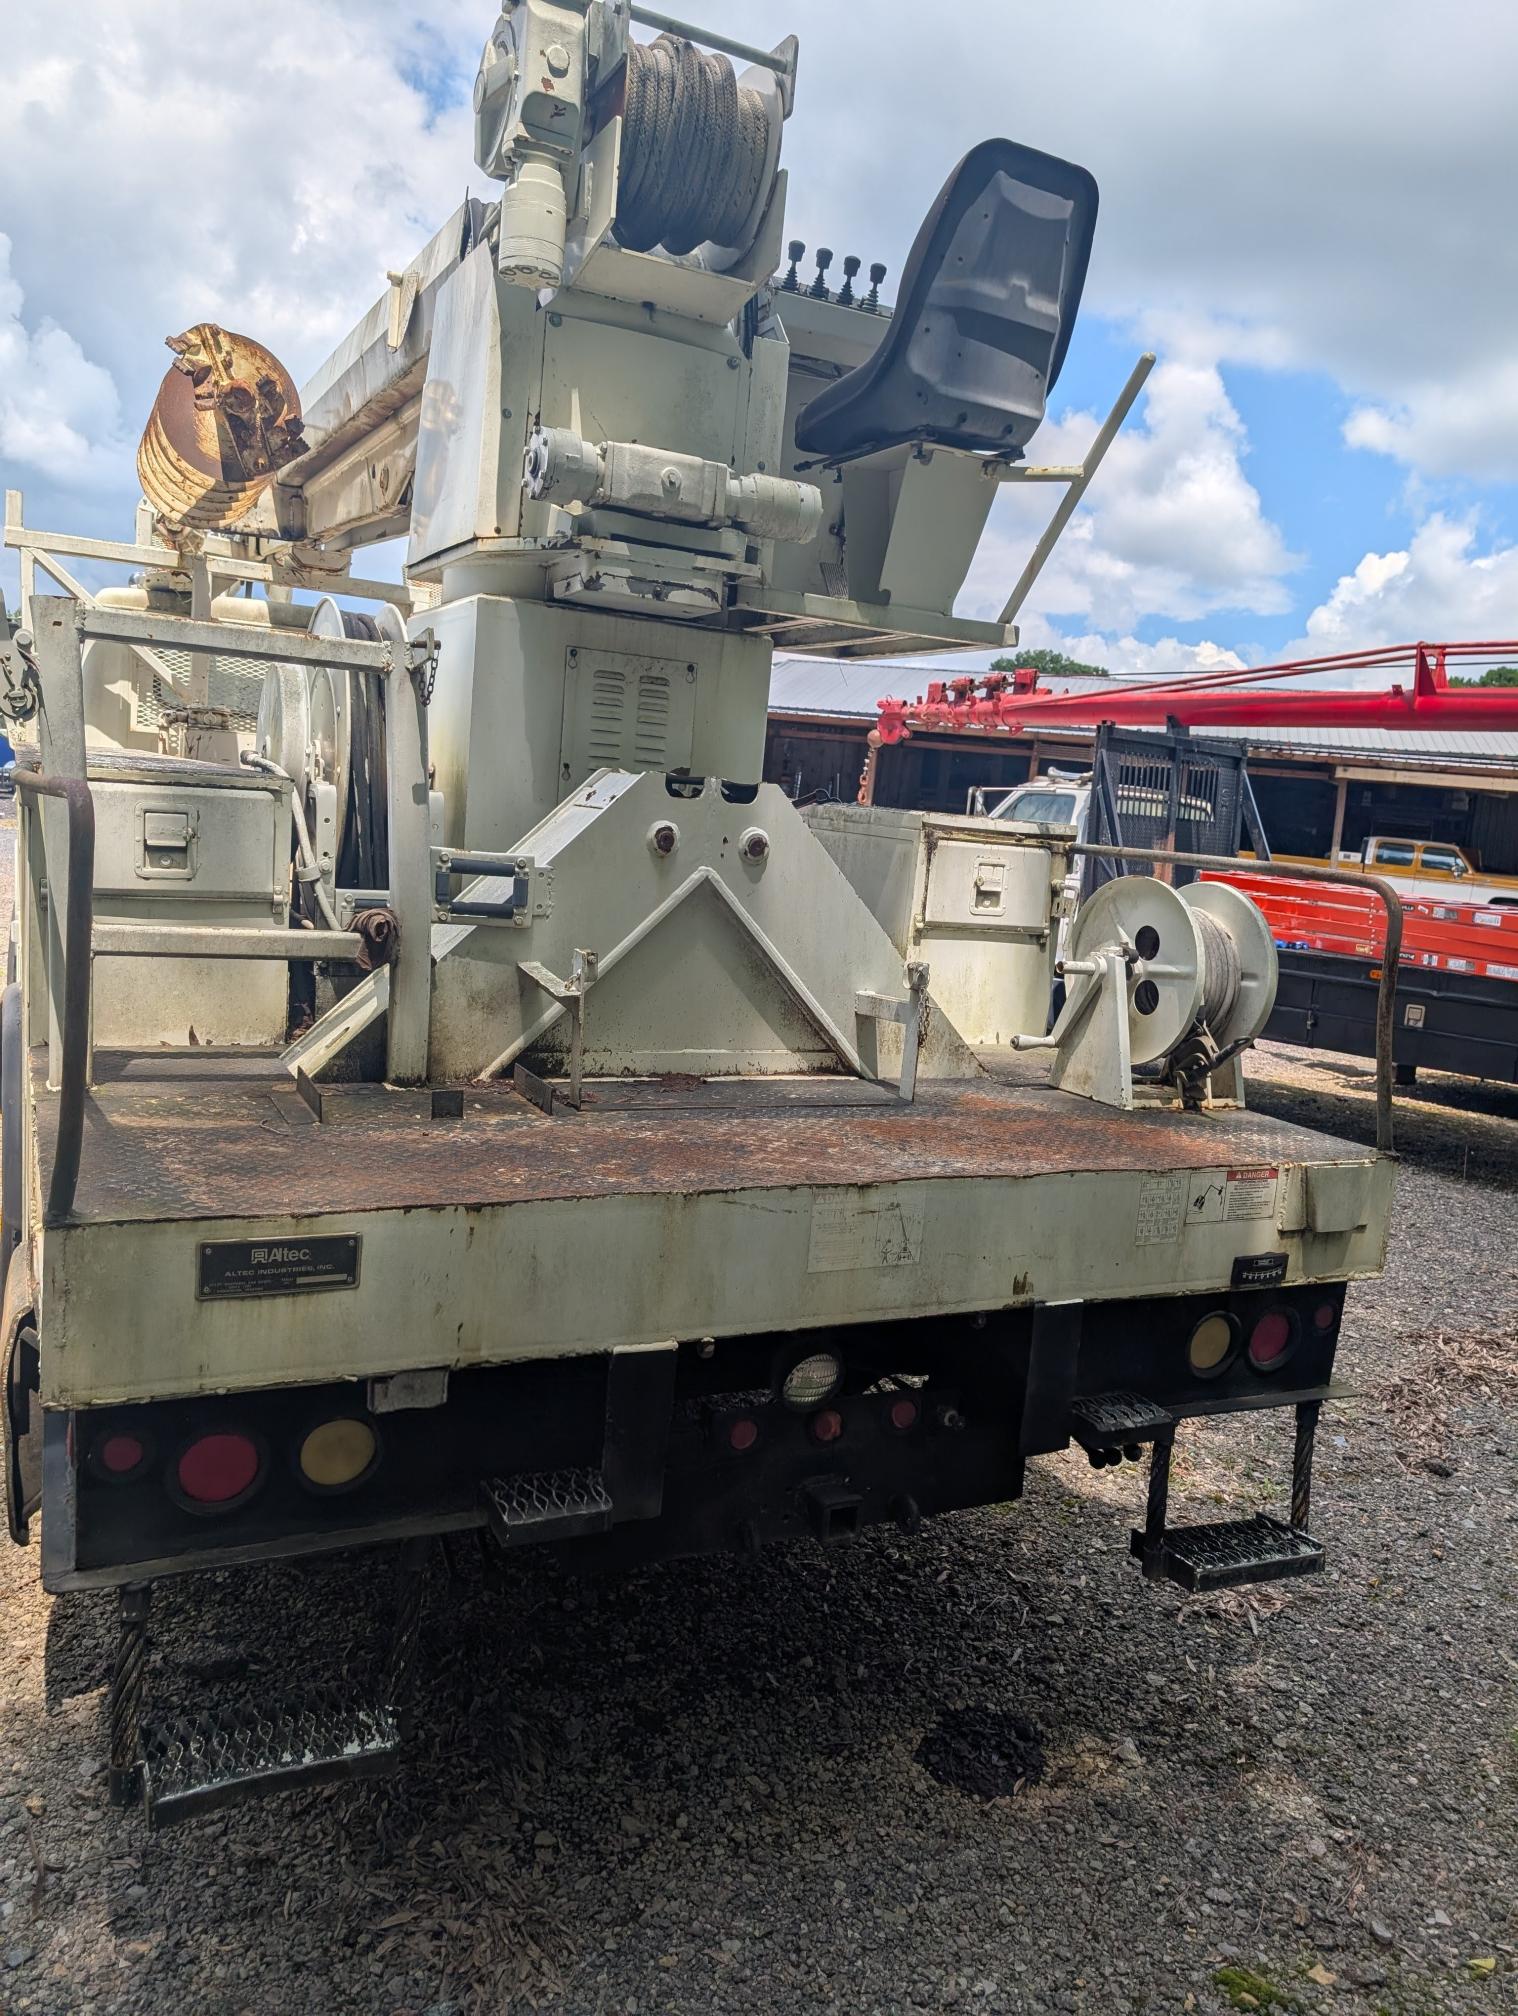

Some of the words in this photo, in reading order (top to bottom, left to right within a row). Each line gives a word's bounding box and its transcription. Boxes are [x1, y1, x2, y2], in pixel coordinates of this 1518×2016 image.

[1243, 1171, 1270, 1179] DANGER
[267, 1248, 311, 1263] Altec
[257, 1265, 316, 1275] INDUSTRIES,
